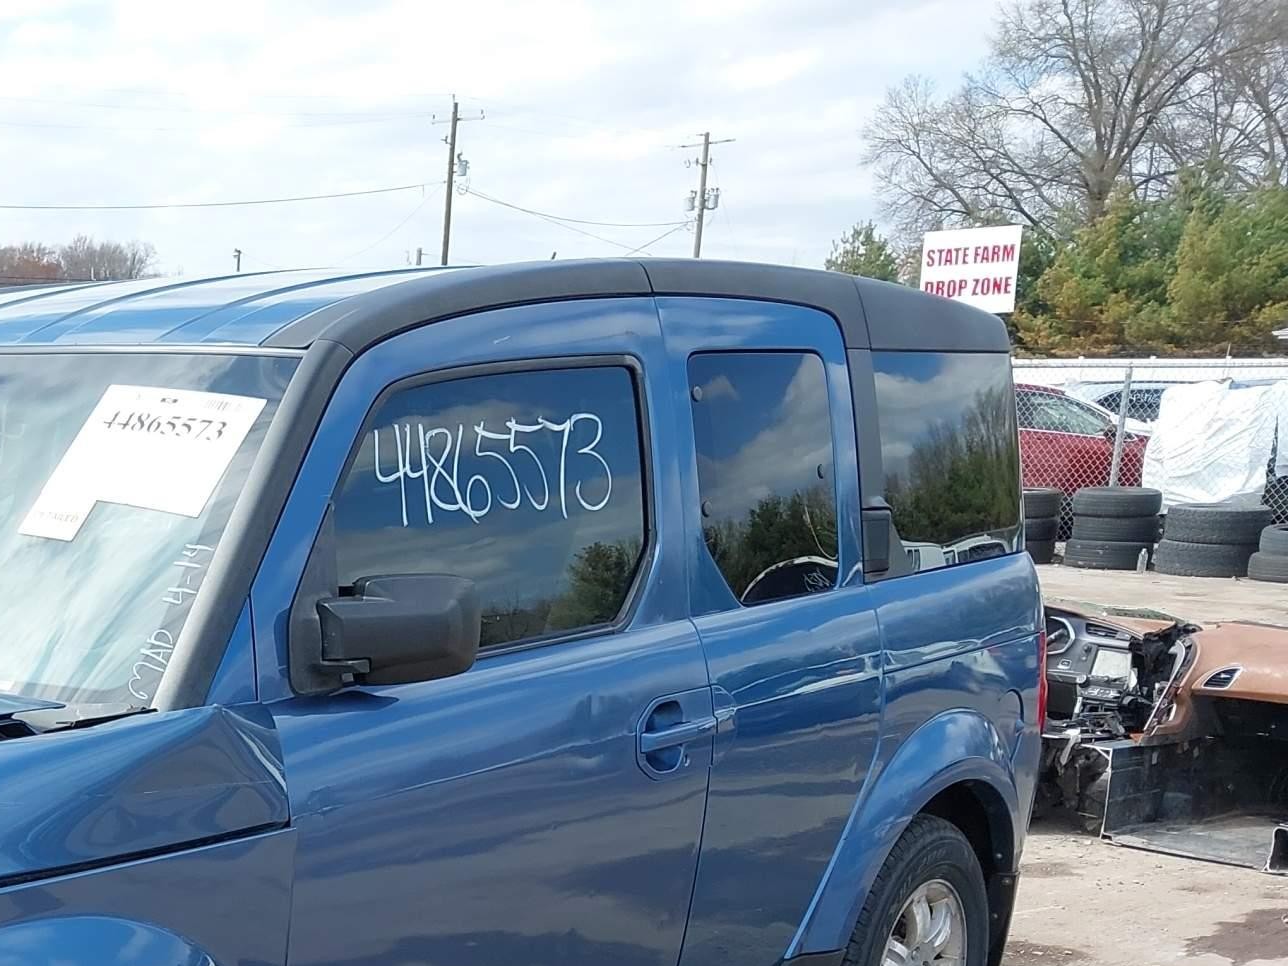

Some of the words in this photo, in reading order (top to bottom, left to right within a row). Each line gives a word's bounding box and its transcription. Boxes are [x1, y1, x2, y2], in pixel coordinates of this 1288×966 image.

[925, 246, 970, 268] STATE
[973, 243, 1016, 265] FARM
[924, 278, 968, 298] DROP
[971, 275, 1013, 297] ZONE
[373, 411, 613, 528] 44865573
[162, 543, 216, 605] 4-14
